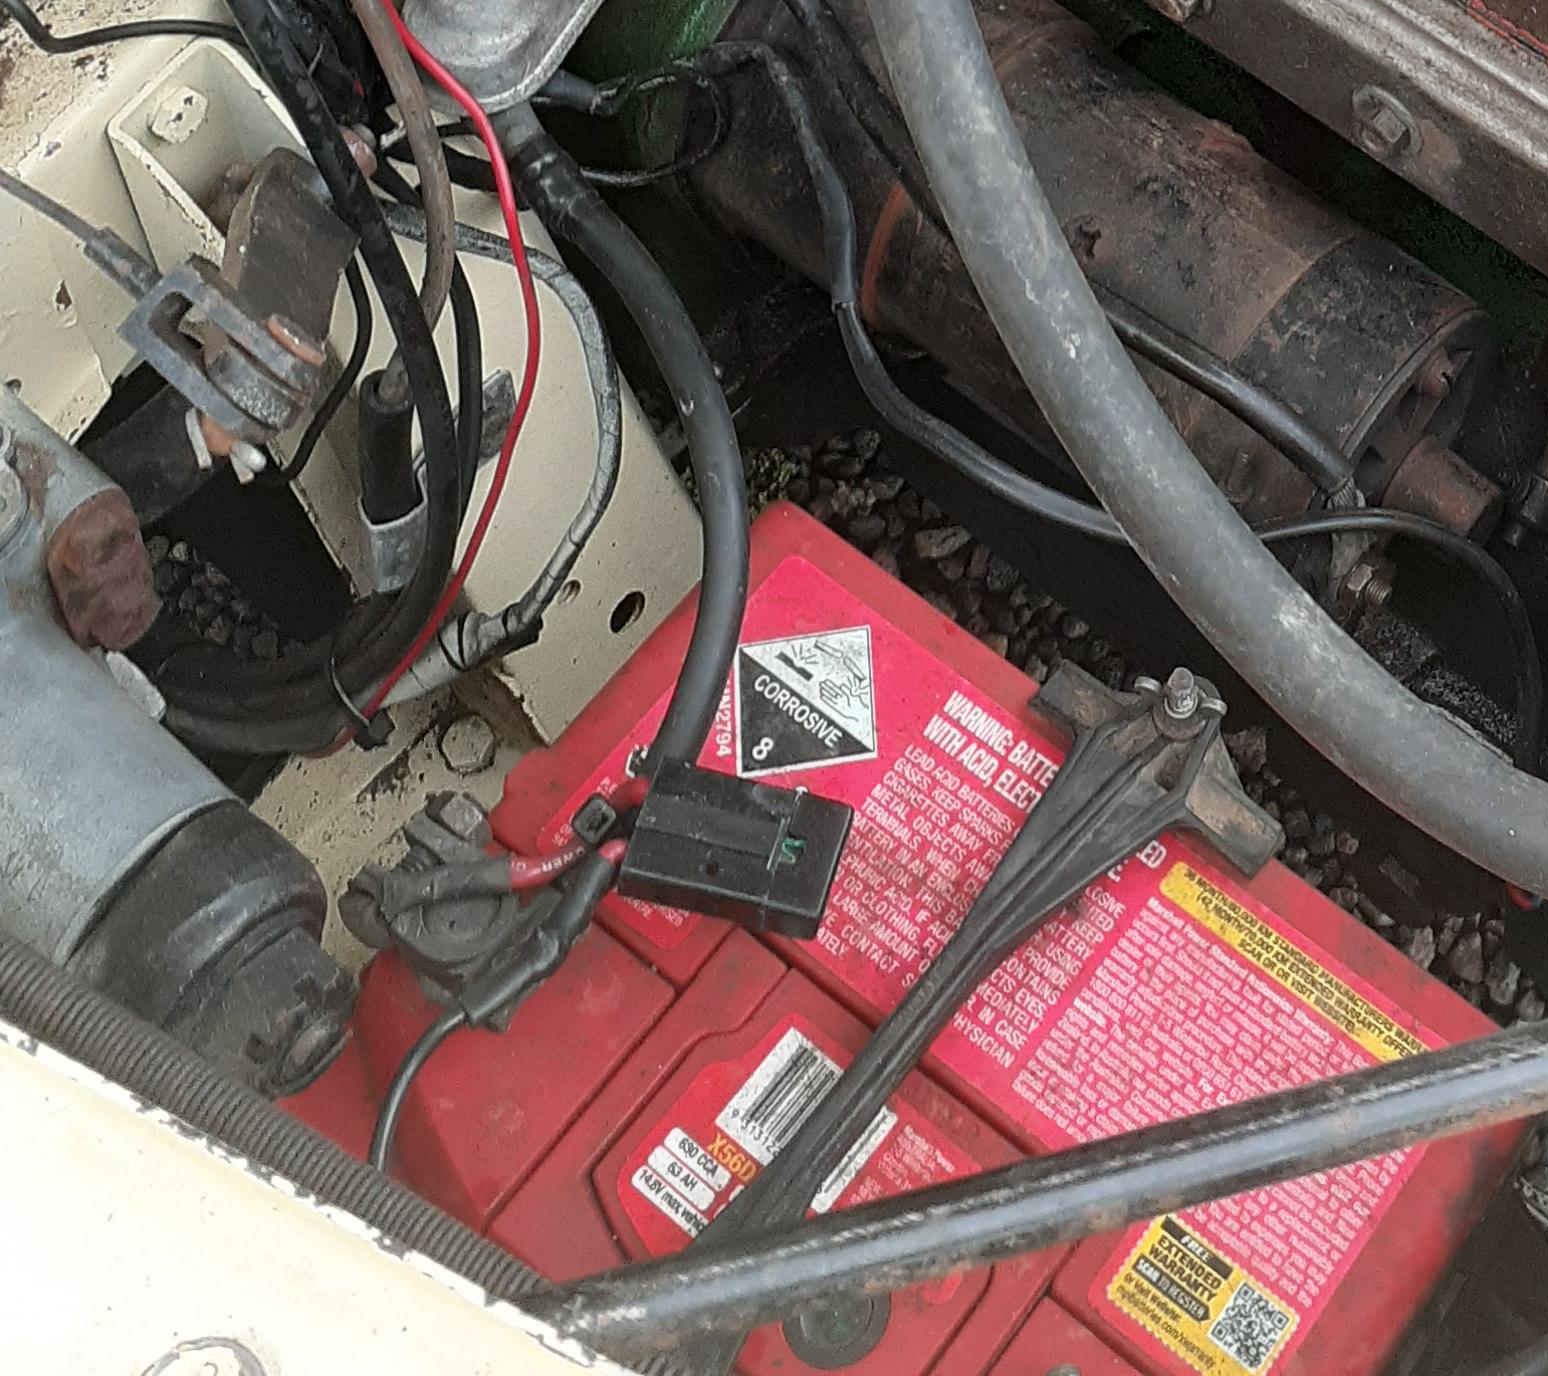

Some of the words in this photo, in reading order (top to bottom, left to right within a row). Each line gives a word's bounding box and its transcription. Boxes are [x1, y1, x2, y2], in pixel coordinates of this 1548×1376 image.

[750, 672, 844, 748] CORROSIVE
[749, 734, 775, 763] 8
[921, 714, 967, 756] WITH
[953, 740, 1004, 788] ACID,
[992, 768, 1043, 814] ELECT
[941, 690, 1018, 756] WARNING:
[1007, 739, 1060, 788] BATTE
[880, 770, 950, 827] CIGARETTES
[948, 821, 982, 852] AWAY
[902, 743, 936, 773] LEAD
[931, 764, 961, 791] ACID
[956, 784, 1016, 833] BATTERIES
[869, 783, 912, 820] METAL
[910, 815, 967, 862] OBJECTS
[930, 786, 961, 814] KEEP
[957, 807, 1003, 846] SPARKS
[838, 850, 886, 890] LPHURIC
[914, 909, 930, 925] IF
[841, 875, 862, 895] OR
[893, 846, 912, 865] IN
[908, 857, 928, 877] AN
[924, 872, 975, 915] ENCLOS
[924, 846, 962, 880] WHEN
[914, 885, 946, 914] THIS
[831, 890, 871, 925] LARGE
[867, 919, 919, 962] AMOUNT
[838, 923, 901, 975] CONTACT
[1041, 917, 1094, 961] ATTERY
[1070, 917, 1104, 947] KEEP
[999, 954, 1062, 1006] ONTAINS
[1020, 947, 1072, 990] PROVIDE
[1043, 942, 1082, 976] USING
[947, 1012, 1016, 1069] HYSICIAN
[976, 1007, 994, 1024] IN
[992, 1019, 1028, 1051] CASE
[679, 1172, 698, 1190] AH
[695, 1153, 720, 1177] CCA
[1135, 1258, 1161, 1282] SCAN
[1145, 1244, 1217, 1303] WARRANTY
[1154, 1234, 1223, 1290] EXTENDED
[1179, 1233, 1213, 1262] FREE
